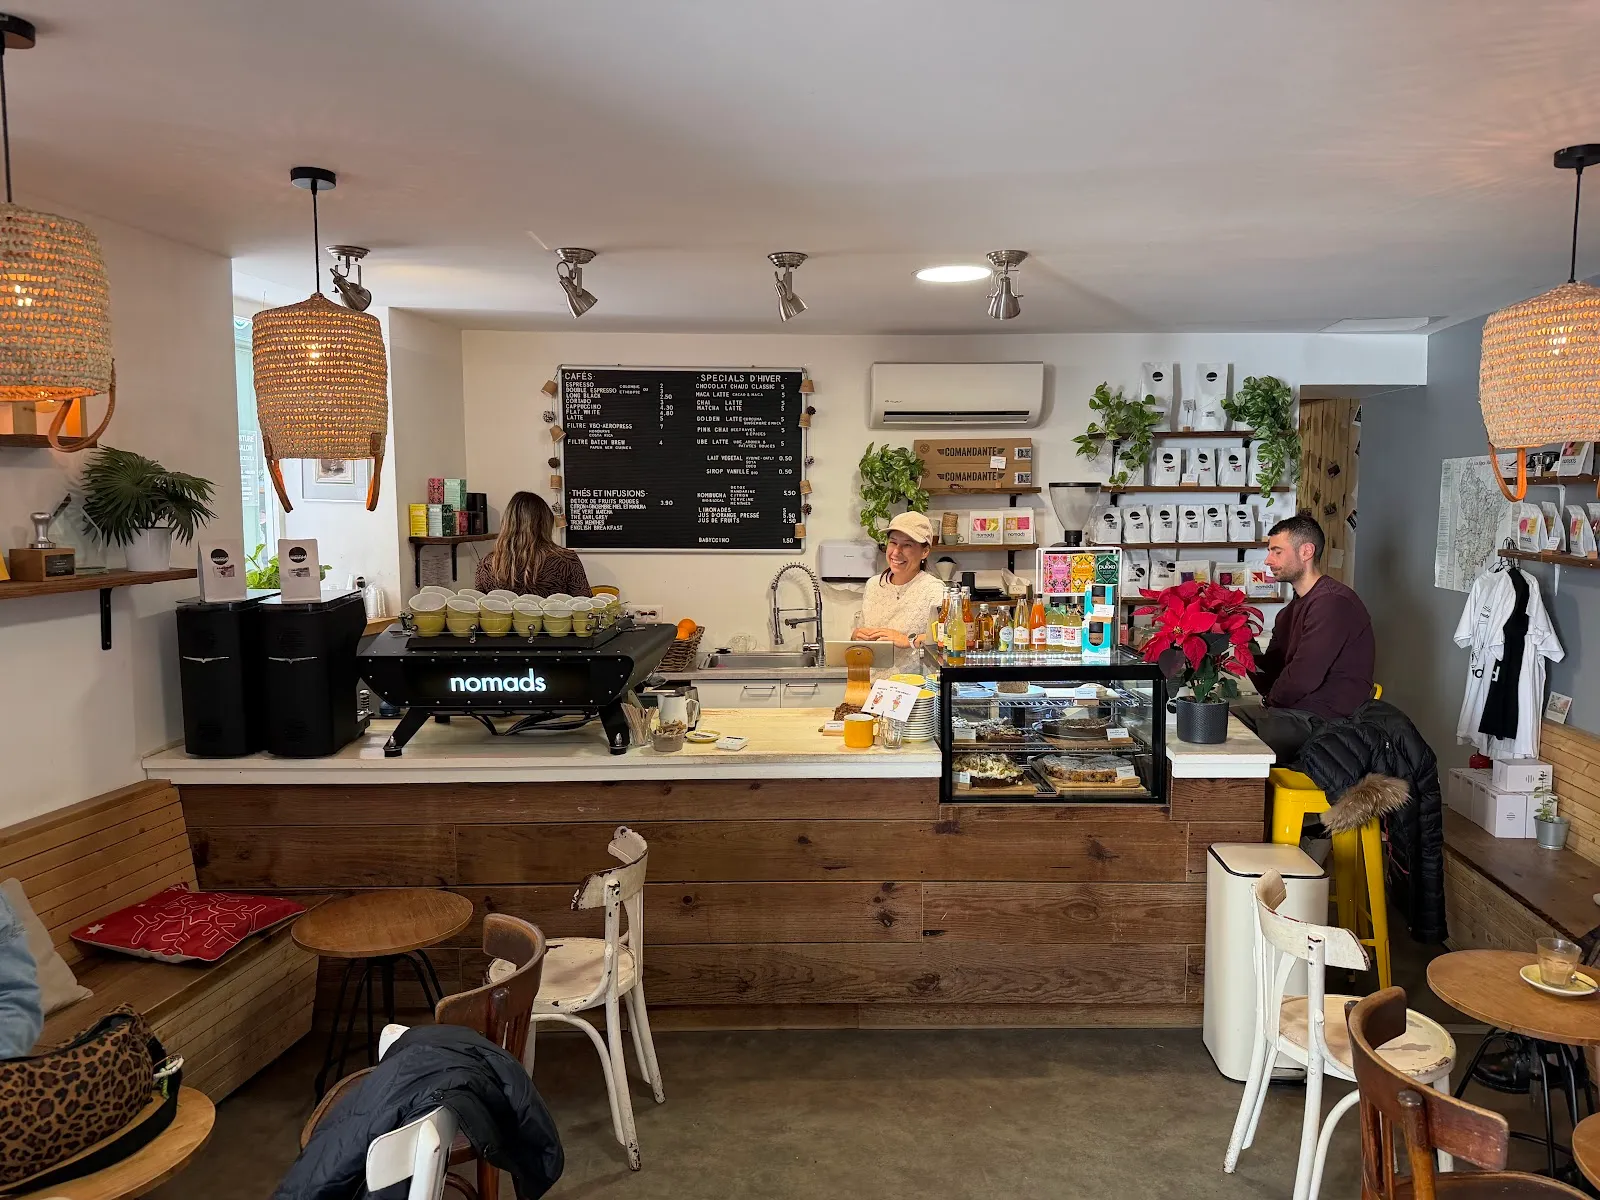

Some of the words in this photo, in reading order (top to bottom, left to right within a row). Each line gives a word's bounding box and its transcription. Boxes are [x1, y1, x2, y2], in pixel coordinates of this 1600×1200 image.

[945, 446, 997, 457] COMANDANTE
[945, 472, 997, 481] COMANDANTE
[450, 668, 547, 692] nomads
